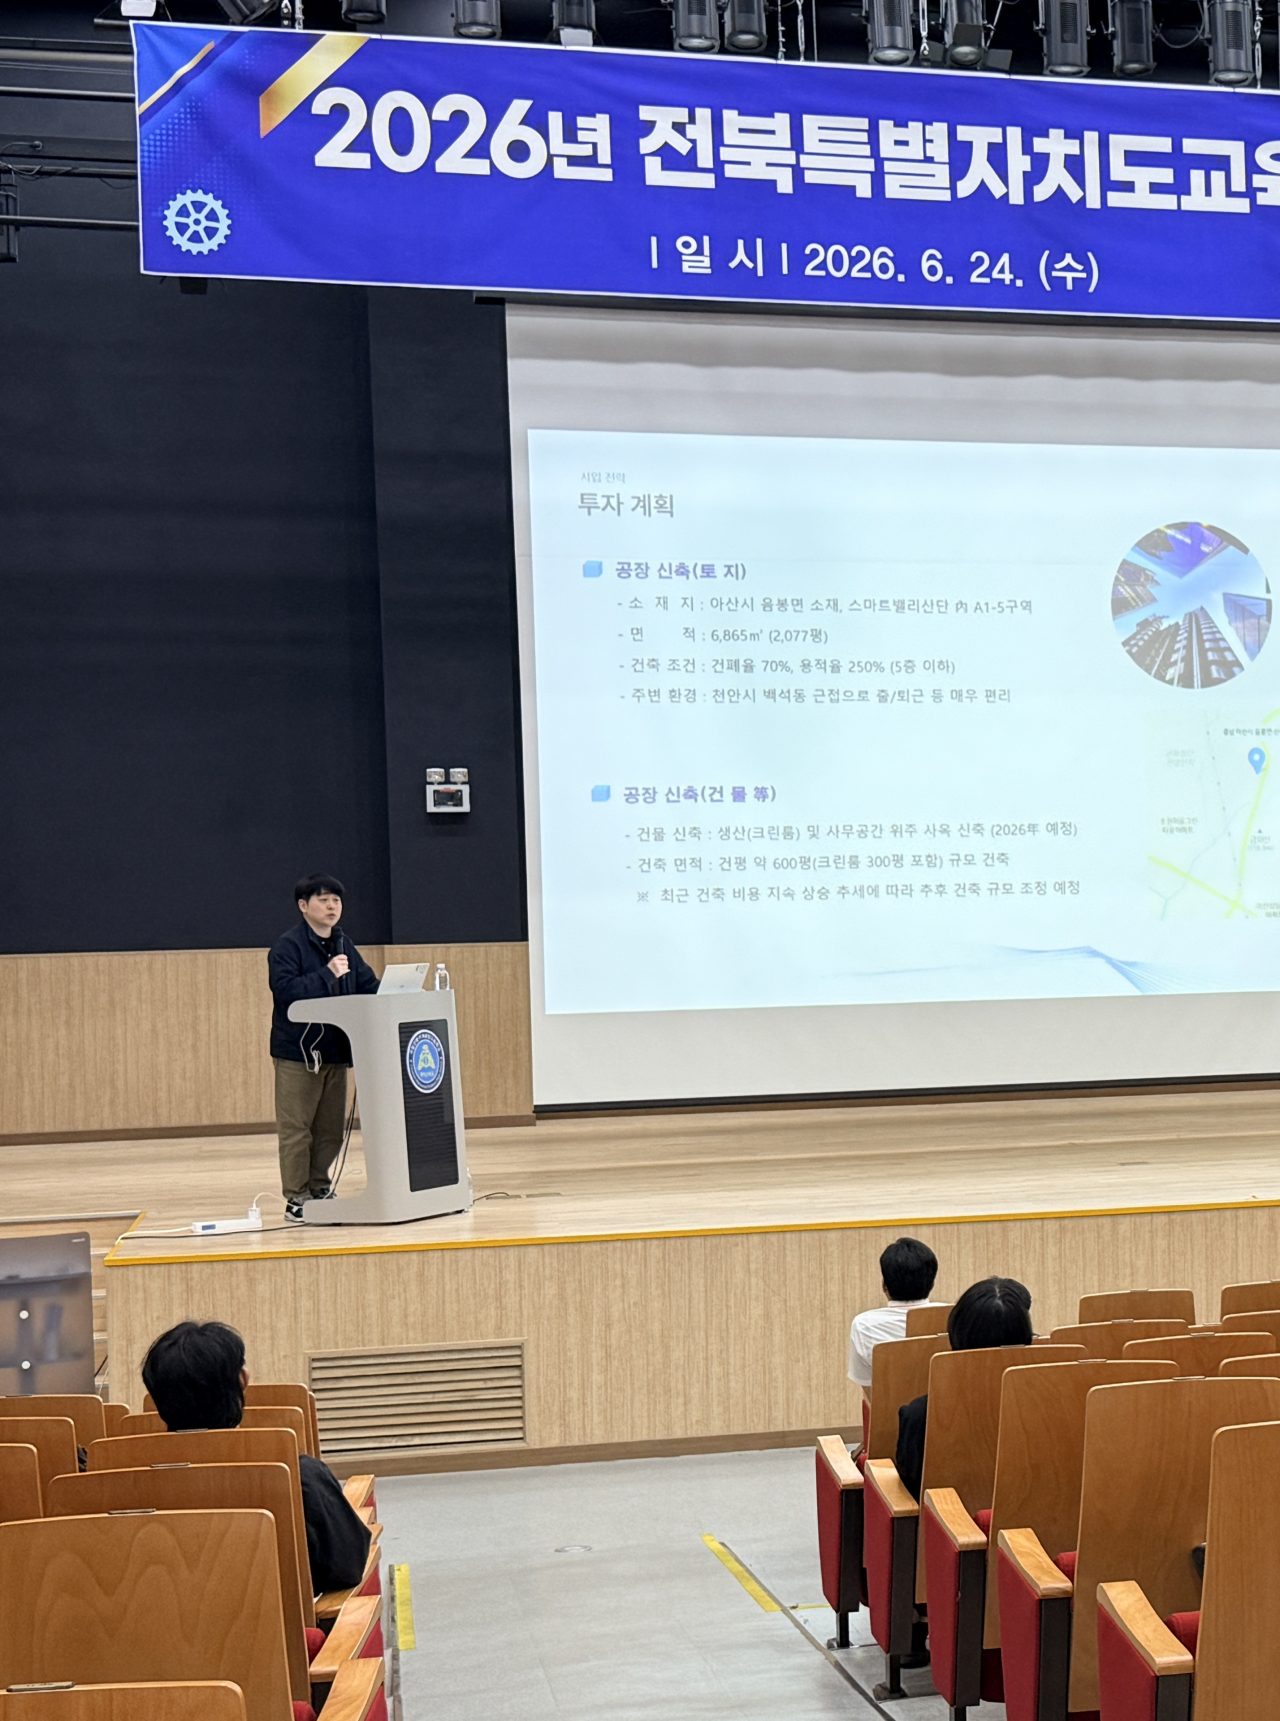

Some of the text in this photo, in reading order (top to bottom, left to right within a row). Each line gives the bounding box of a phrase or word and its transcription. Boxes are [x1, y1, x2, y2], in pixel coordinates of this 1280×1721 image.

[311, 87, 613, 182] 2026년
[676, 236, 711, 273] 일
[729, 238, 763, 276] 시
[805, 244, 904, 281] 2026.
[922, 249, 953, 283] 6.
[970, 251, 1022, 286] 24.
[1040, 251, 1098, 292] (수)
[578, 493, 674, 518] 투자 계획
[616, 561, 746, 581] 공장 신축(토 지)
[710, 597, 754, 612] 아산시
[761, 597, 803, 613] 음봉면
[810, 598, 842, 613] 소재,
[848, 599, 948, 614] 스마트밸리산단
[974, 600, 1032, 614] A1-5구역
[769, 628, 828, 644] (2,077평)
[632, 658, 660, 673] 건축
[667, 658, 695, 673] 조건
[712, 658, 755, 673] 건폐율
[761, 660, 793, 674] 70%,
[800, 659, 842, 674] 용적율
[848, 661, 885, 673] 250%
[890, 659, 916, 675] (5층
[923, 659, 955, 674] 이하)
[632, 688, 660, 703] 주변
[669, 688, 696, 703] 환경
[712, 688, 755, 703] 천안시
[763, 688, 806, 703] 백석동
[813, 689, 870, 704] 근접으로
[931, 689, 944, 703] 등
[950, 689, 978, 703] 매우
[985, 689, 1010, 703] 편리
[624, 787, 658, 804] 공장
[665, 785, 724, 803] 신축(건
[637, 827, 666, 842] 건물
[673, 826, 702, 842] 신축
[718, 825, 800, 842] 생산(크린룸)
[807, 824, 819, 840] 및
[826, 824, 883, 839] 사무공간
[890, 824, 918, 838] 위주
[924, 823, 951, 838] 사옥
[958, 822, 985, 838] 신축
[991, 823, 1039, 838] (2026年
[1046, 821, 1077, 837] 예정)
[638, 858, 667, 873] 건축
[674, 857, 702, 872] 면적
[719, 856, 746, 871] 건평
[754, 856, 767, 871] 약
[773, 855, 861, 871] 600평(크린룸
[867, 854, 904, 868] 300평
[911, 854, 943, 869] 포함)
[949, 853, 976, 867] 규모
[983, 852, 1010, 867] 건축
[661, 888, 689, 903] 최근
[697, 888, 725, 903] 건축
[733, 886, 761, 902] 비용
[768, 886, 796, 901] 지속
[802, 886, 830, 901] 상승
[837, 884, 879, 899] 추세에
[886, 884, 914, 898] 따라
[920, 883, 948, 898] 추후
[954, 882, 981, 897] 건축
[987, 882, 1015, 896] 규모
[1020, 881, 1047, 896] 조정
[1053, 880, 1080, 895] 예정
